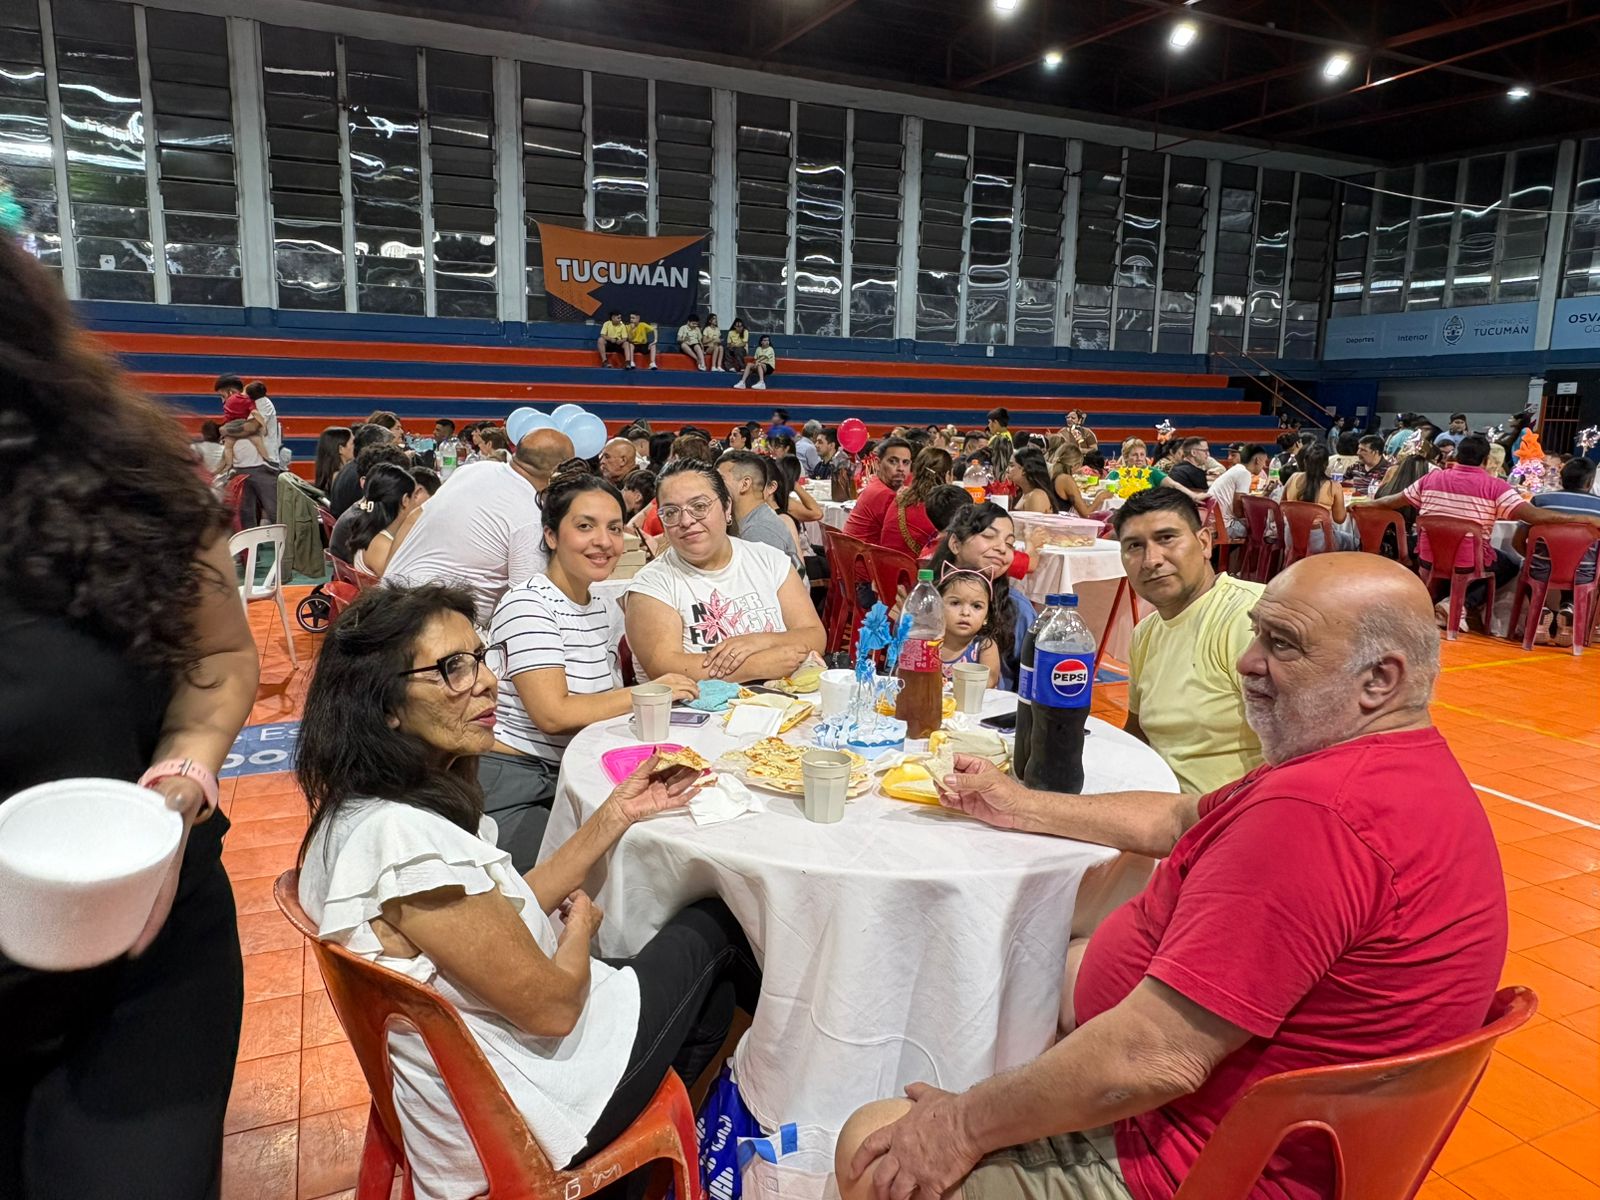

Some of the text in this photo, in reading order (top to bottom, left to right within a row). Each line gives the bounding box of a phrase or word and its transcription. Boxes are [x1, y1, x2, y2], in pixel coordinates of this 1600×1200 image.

[555, 258, 689, 289] TUCUMÁN
[1473, 323, 1529, 337] TUCUMÁN
[1345, 336, 1375, 345] Deportes
[1397, 333, 1429, 342] Interior
[1053, 672, 1087, 682] PEPSI
